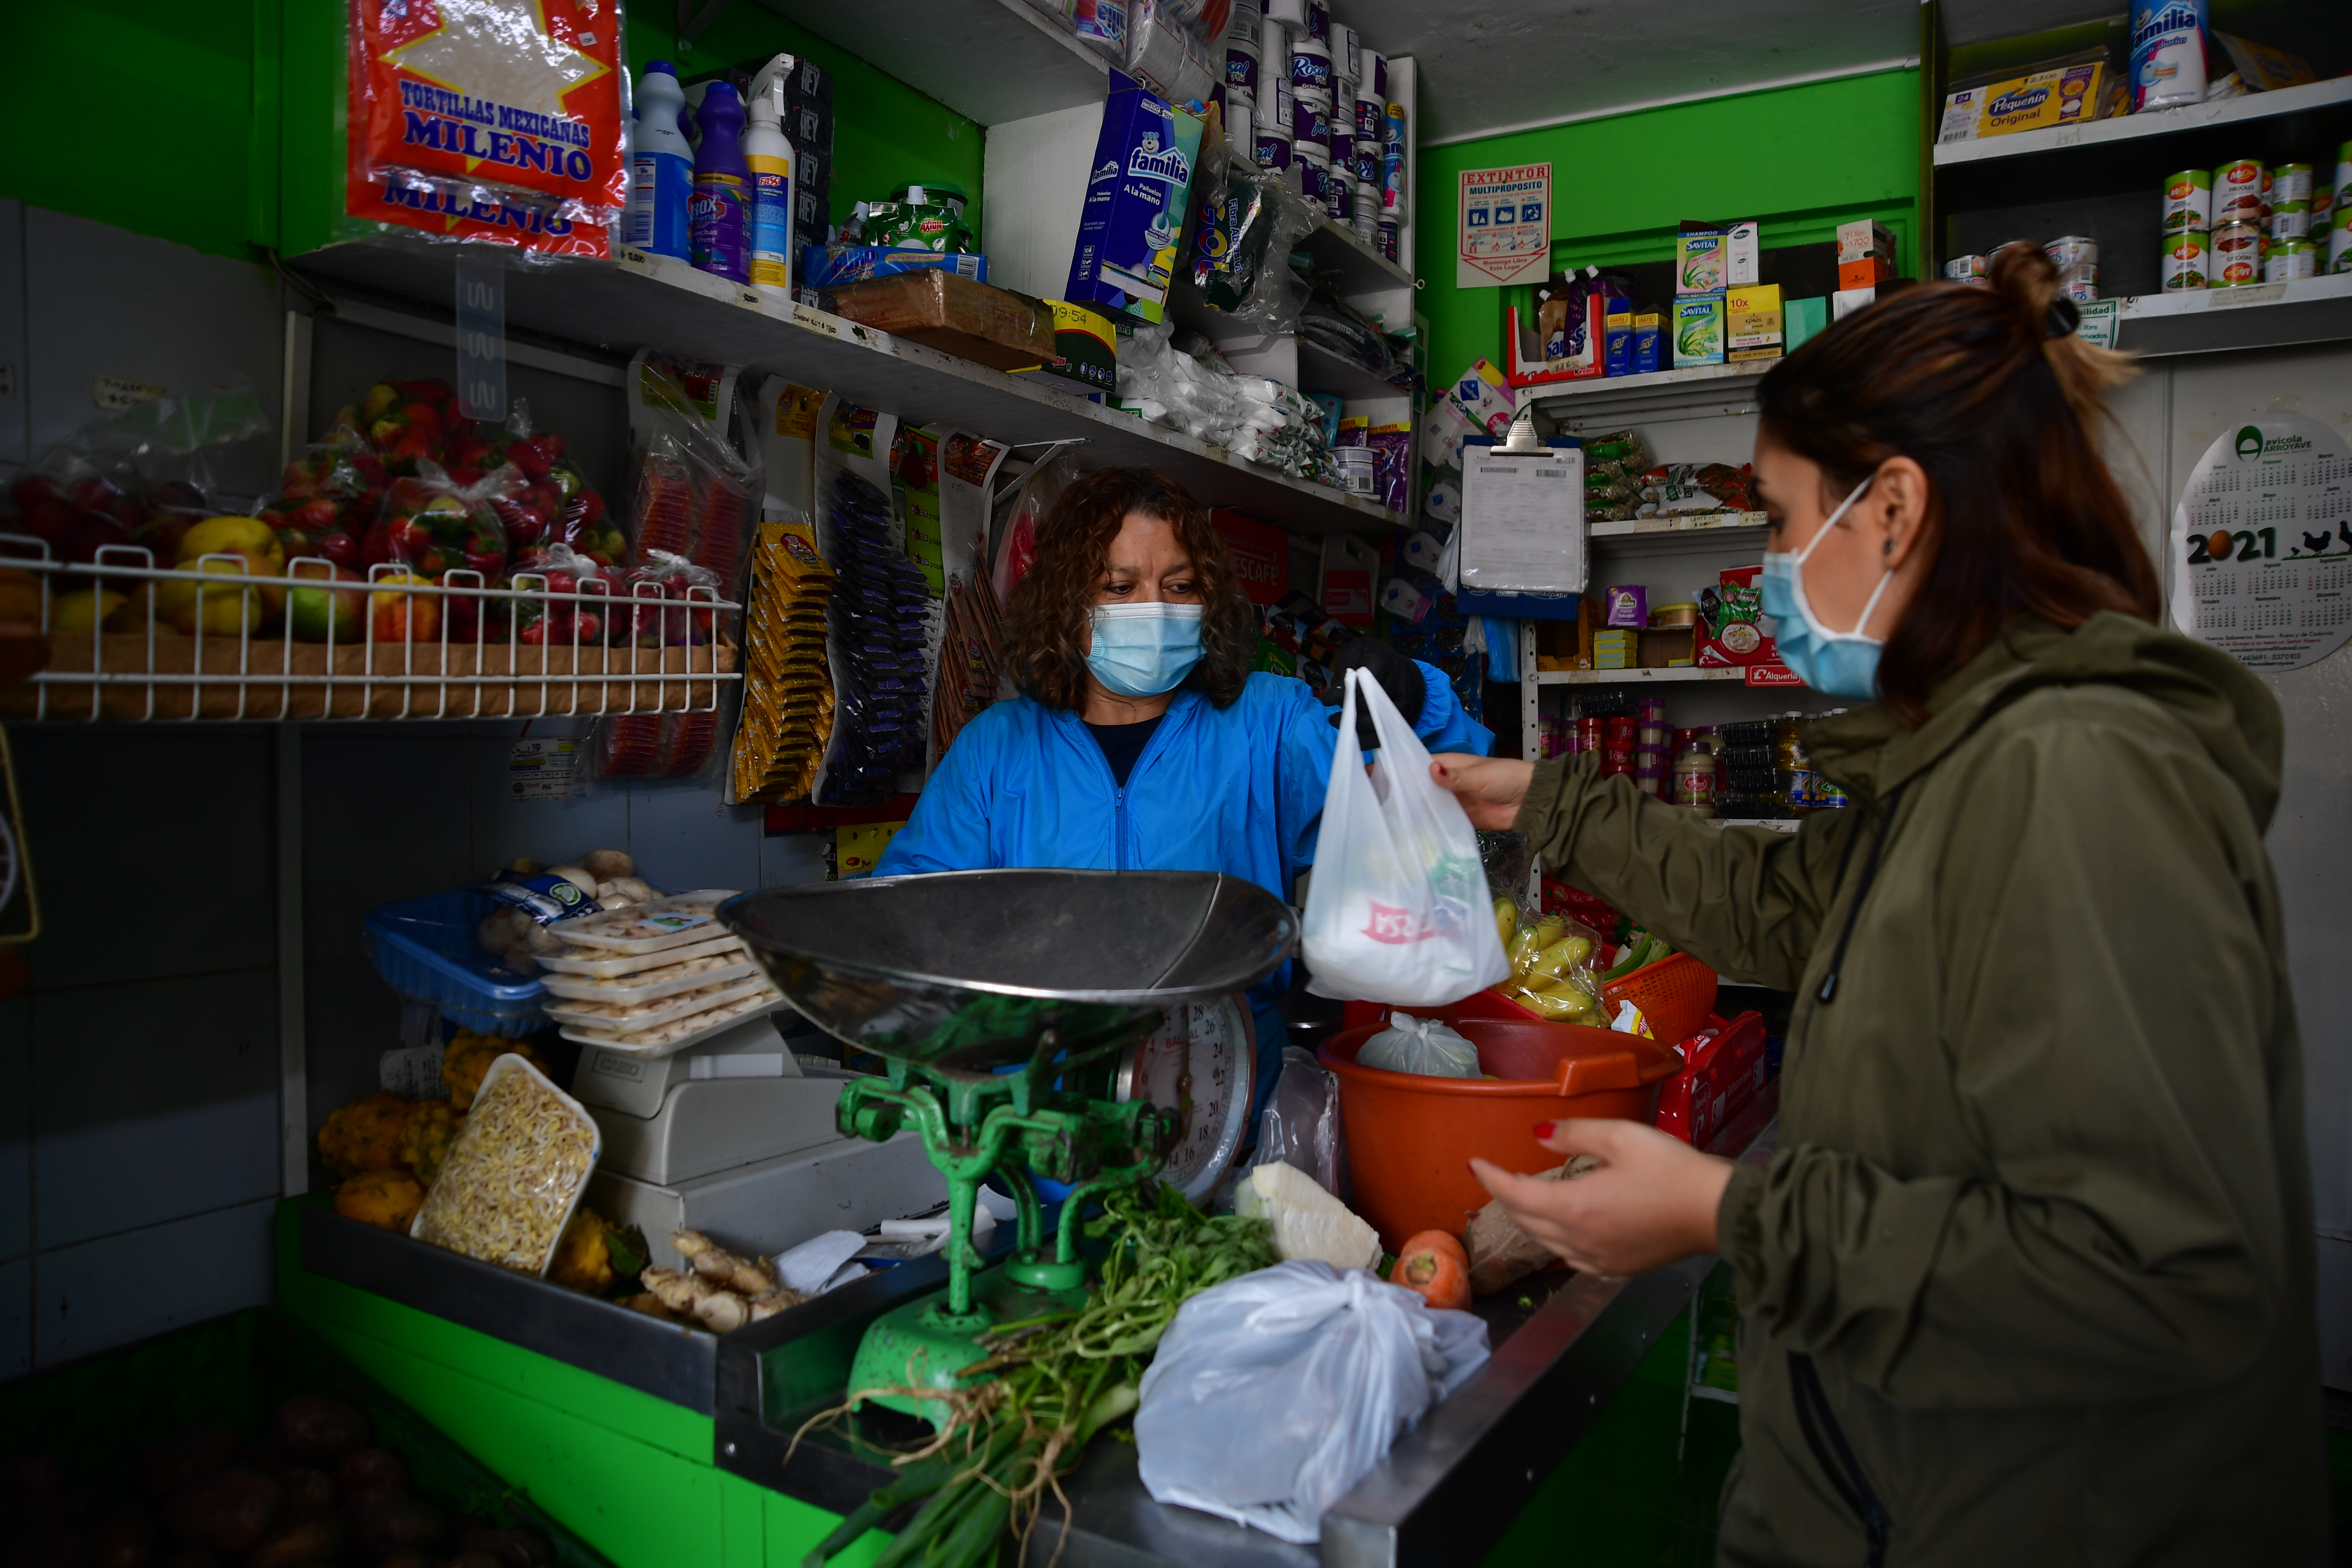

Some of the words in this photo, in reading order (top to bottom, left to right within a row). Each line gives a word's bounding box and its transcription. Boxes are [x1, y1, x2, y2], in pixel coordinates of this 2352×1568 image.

[1292, 57, 1330, 77] Rosal
[801, 64, 819, 97] REY
[1230, 73, 1246, 82] Plus
[1315, 76, 1327, 85] Plus
[1302, 83, 1321, 92] Grand
[1143, 99, 1160, 110] PRECIO
[1957, 95, 1968, 103] 24
[1992, 92, 2046, 113] Pequeñín
[400, 79, 495, 126] TORTILLAS
[498, 106, 590, 149] MEXICANAS
[1990, 109, 2041, 127] Original
[800, 112, 818, 143] REY
[402, 110, 593, 182] MILENIO
[800, 155, 819, 186] REY
[1092, 165, 1117, 180] familia
[1131, 149, 1188, 183] familia
[1467, 167, 1545, 184] EXTINTOR
[1124, 184, 1130, 193] A
[1131, 186, 1138, 196] la
[1139, 191, 1160, 206] mano
[1139, 183, 1162, 198] Pañuelos
[1469, 180, 1542, 195] MULTIPROPOSITO
[2229, 184, 2254, 192] FRIJOLES
[382, 172, 574, 237] MILENIO
[798, 195, 817, 225] REY
[1228, 198, 1238, 226] Fibra
[920, 220, 942, 232] AXION
[1230, 227, 1242, 273] Abrasiva
[1687, 240, 1717, 250] SAVITAL
[832, 248, 877, 277] PURO
[1842, 254, 1858, 262] MUJER
[844, 265, 873, 280] Bicarbonato
[800, 286, 819, 297] Jabón
[1730, 298, 1749, 308] 10x
[1681, 307, 1711, 316] SAVITAL
[1461, 381, 1478, 400] Nosotras
[2264, 441, 2311, 452] ARROYAVE
[929, 537, 942, 546] próspe
[2186, 527, 2276, 564] 2021
[930, 561, 944, 571] próspe
[1236, 552, 1280, 587] ESCAFÉ
[931, 585, 944, 594] próspe
[1327, 593, 1349, 603] Colgate
[1192, 1004, 1204, 1022] 28
[1205, 1019, 1215, 1034] 26
[1213, 1043, 1223, 1058] 24
[600, 1056, 639, 1076] CASIO
[1215, 1070, 1225, 1086] 22
[1208, 1100, 1219, 1118] 20
[1198, 1124, 1209, 1141] 18
[1168, 1151, 1179, 1168] 14
[1184, 1146, 1195, 1162] 16
